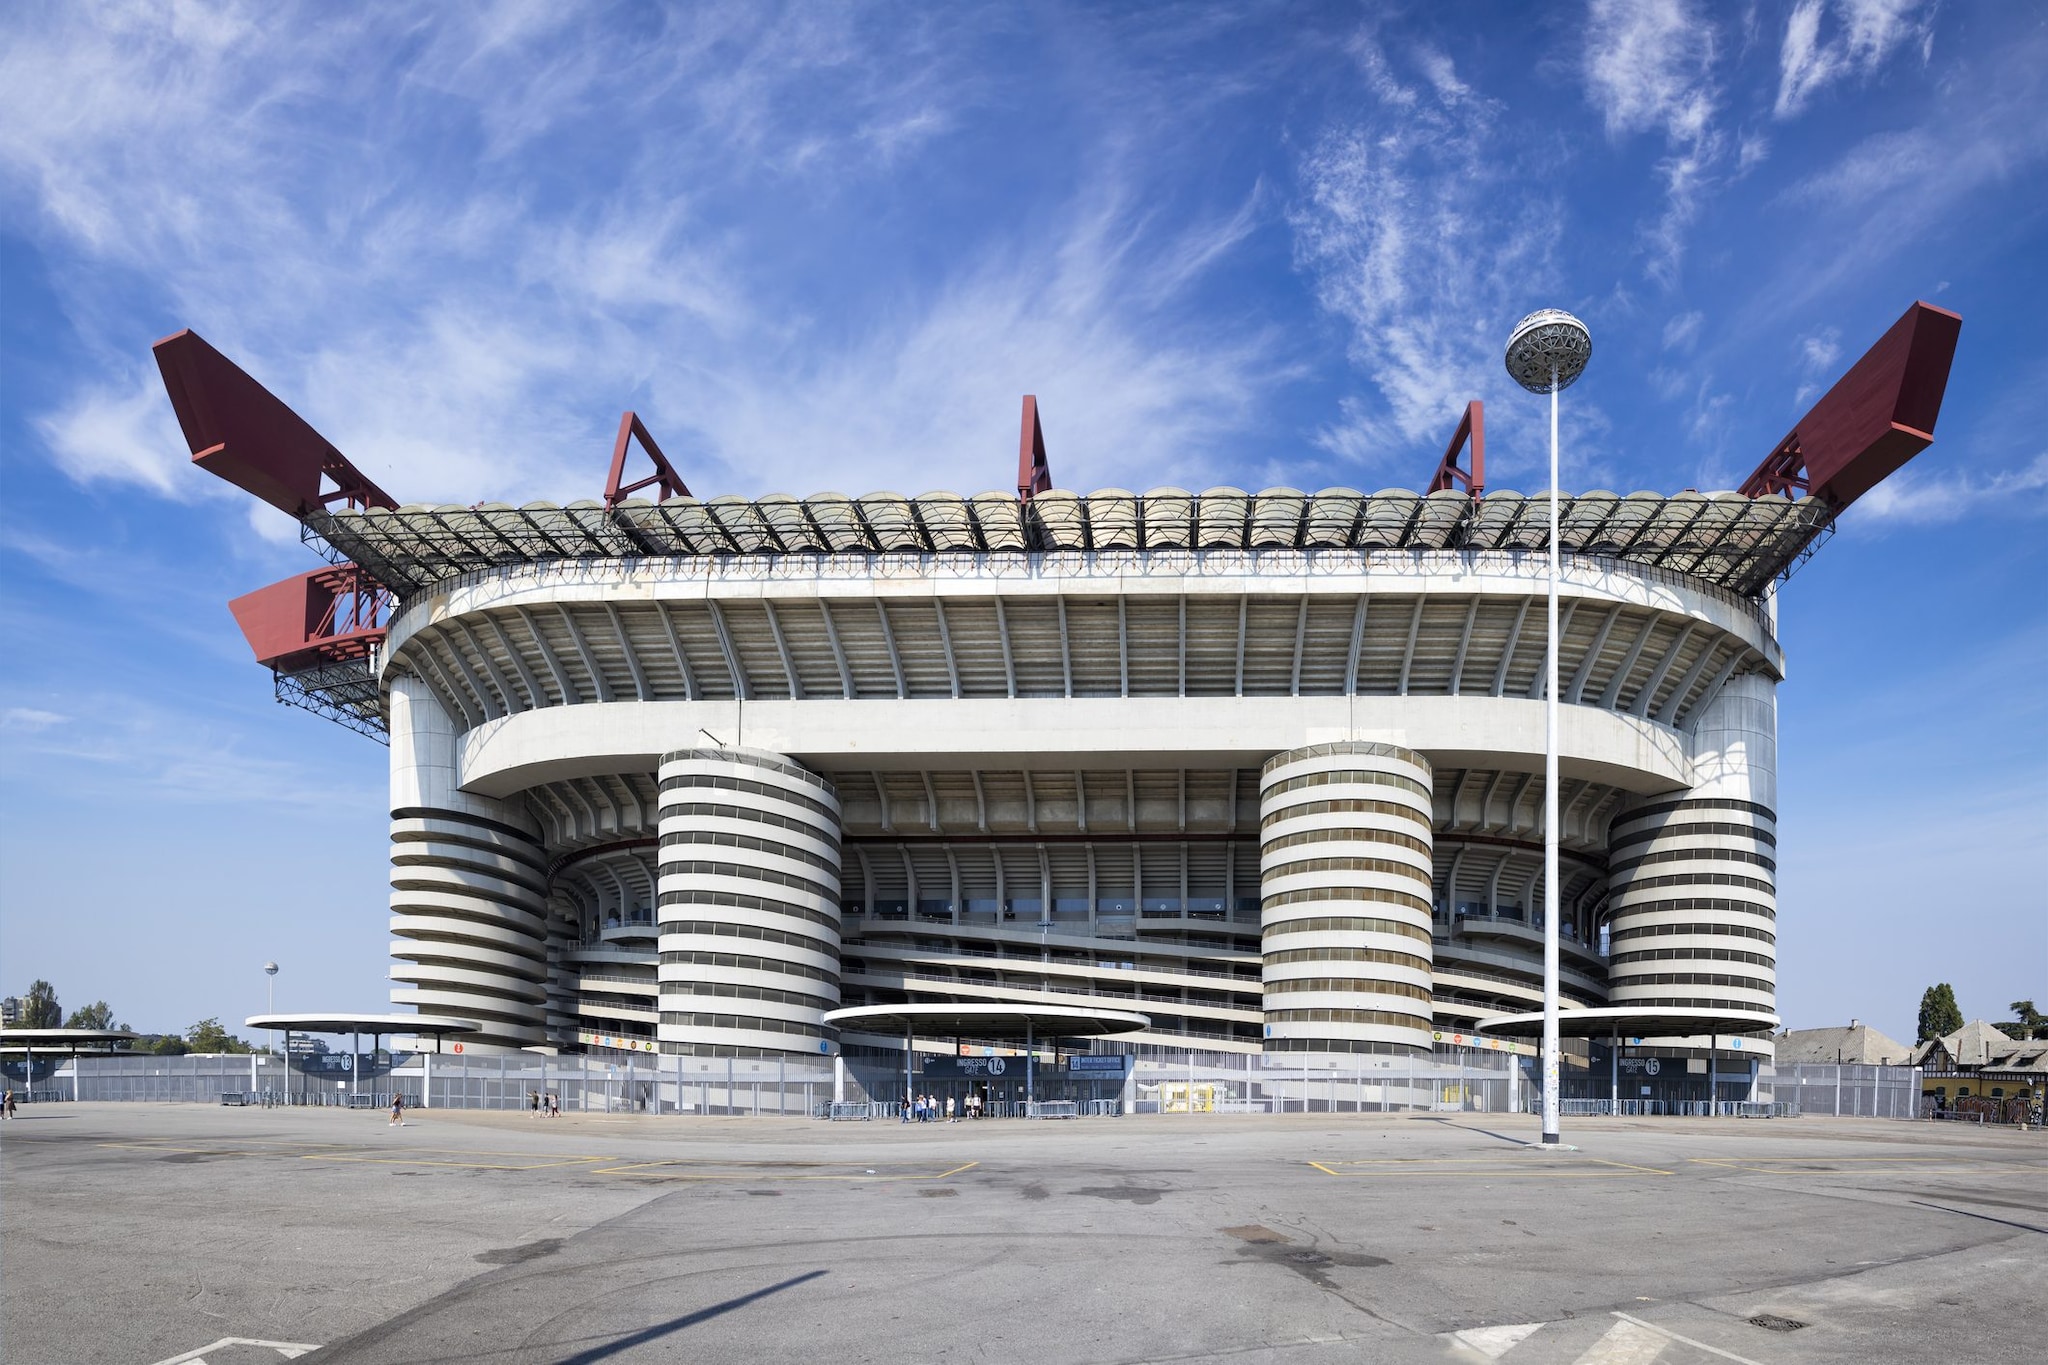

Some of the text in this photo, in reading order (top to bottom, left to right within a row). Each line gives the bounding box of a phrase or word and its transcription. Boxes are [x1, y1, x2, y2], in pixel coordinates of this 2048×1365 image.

[957, 1058, 987, 1067] INGRESSO
[991, 1060, 1003, 1073] 14
[1619, 1058, 1645, 1067] INGRESSO
[965, 1066, 979, 1075] GATE
[1626, 1066, 1638, 1074] GATE
